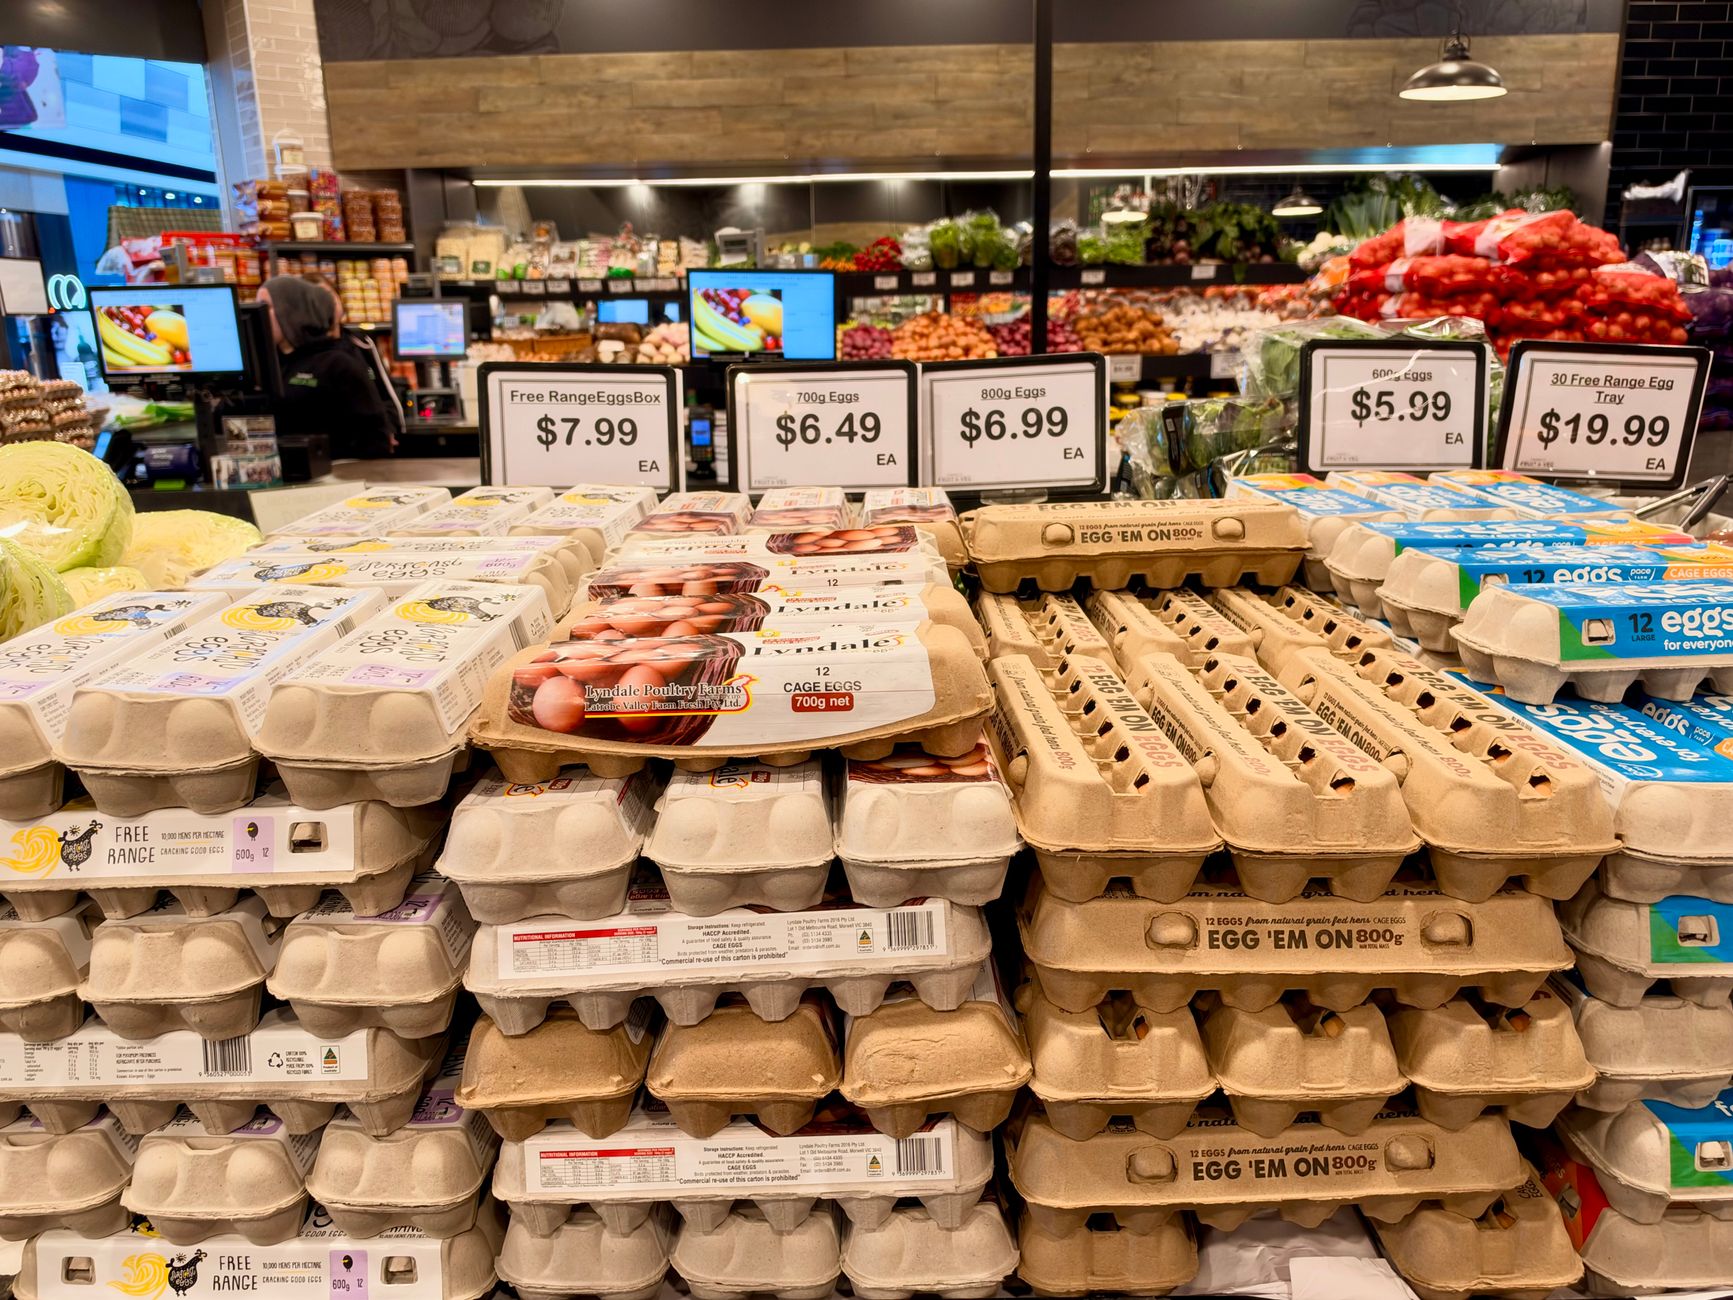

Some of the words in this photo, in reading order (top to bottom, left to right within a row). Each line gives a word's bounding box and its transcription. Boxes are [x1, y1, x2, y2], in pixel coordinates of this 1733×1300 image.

[1404, 369, 1433, 382] Eggs
[1551, 373, 1567, 385] 30
[1571, 374, 1599, 386] Free
[1603, 375, 1646, 389] Range
[1649, 377, 1674, 391] Egg
[510, 390, 545, 403] Free
[549, 391, 660, 406] RangeEggsBox
[797, 392, 826, 404] 700g
[829, 391, 860, 403] Eggs
[981, 388, 1011, 400] 800g
[1015, 387, 1046, 399] Eggs
[1596, 391, 1625, 404] Tray
[1351, 386, 1452, 428] $5.99
[536, 413, 638, 452] $7.99
[775, 411, 881, 452] $6.49
[960, 406, 1068, 449] $6.99
[1537, 408, 1670, 450] $19.99
[1445, 433, 1464, 444] EA
[876, 454, 897, 466] EA
[1063, 447, 1084, 459] EA
[638, 460, 660, 473] EA
[1646, 458, 1665, 470] EA
[1081, 531, 1113, 543] EGG
[1117, 530, 1143, 542] 'EM
[1147, 529, 1171, 541] ON
[1172, 528, 1203, 538] 800g
[827, 579, 839, 587] 12
[1523, 569, 1545, 584] 12
[1553, 566, 1622, 583] eggs
[1630, 568, 1651, 576] pace
[1670, 567, 1700, 578] CAGE
[1703, 567, 1733, 578] EGGS
[779, 600, 897, 613] Lyndale
[1628, 613, 1654, 633] 12
[1661, 606, 1733, 637] eggs
[754, 639, 891, 656] Lyndale
[1664, 639, 1681, 650] for
[1682, 639, 1733, 651] everyon
[816, 666, 830, 676] 12
[1081, 664, 1105, 673] 12
[1233, 663, 1260, 674] 12
[1399, 660, 1421, 670] 12
[783, 681, 821, 693] CAGE
[825, 680, 862, 692] EGGS
[1088, 675, 1124, 694] EGG
[1245, 675, 1287, 697] EGG
[1409, 671, 1457, 692] EGG
[585, 684, 640, 701] Lyndale
[643, 682, 697, 699] Poultry
[698, 682, 742, 696] Farms
[584, 701, 621, 712] Latrobe
[623, 700, 651, 712] Valley
[652, 699, 677, 711] Farm
[678, 699, 704, 710] Fresh
[724, 698, 742, 708] Ltd.
[795, 696, 826, 709] 700g
[829, 695, 850, 706] net
[1106, 695, 1140, 712] 'EM
[1274, 698, 1311, 716] 'EM
[1449, 693, 1490, 711] 'EM
[1119, 715, 1157, 732] ON
[1151, 706, 1166, 730] EGG
[1176, 734, 1187, 755] ON
[1294, 718, 1336, 737] ON
[1476, 714, 1523, 732] ON
[1315, 701, 1336, 726] EGG
[1337, 717, 1351, 738] 'EM
[1351, 731, 1365, 751] ON
[1364, 741, 1383, 763] 800g
[1526, 703, 1658, 761] eggs
[1132, 735, 1183, 768] EGGS
[1316, 738, 1380, 772] EGGS
[1505, 734, 1579, 770] EGGS
[1668, 746, 1709, 762] for
[115, 826, 149, 843] FREE
[107, 846, 155, 865] RANGE
[160, 847, 189, 855] CRACKING
[190, 846, 207, 854] GOOD
[209, 846, 224, 854] EGGS
[236, 849, 254, 862] 600g
[262, 847, 269, 858] 12
[1206, 917, 1215, 925] 12
[1217, 917, 1243, 926] EGGS
[1245, 916, 1270, 927] from
[1270, 916, 1305, 925] natural
[1306, 917, 1331, 927] grain
[1331, 916, 1348, 926] fed
[1349, 916, 1370, 925] hens
[1208, 929, 1260, 950] EGG
[1267, 929, 1308, 949] 'EM
[1315, 929, 1353, 949] ON
[1355, 928, 1404, 946] 800g
[1190, 1150, 1199, 1158] 12
[1201, 1149, 1225, 1158] EGGS
[1227, 1148, 1250, 1158] from
[1251, 1146, 1283, 1155] natural
[1284, 1146, 1307, 1156] grain
[1308, 1144, 1325, 1155] fed
[1325, 1144, 1346, 1153] hens
[1347, 1143, 1363, 1151] CAGE
[1363, 1143, 1379, 1151] EGGS
[1192, 1160, 1242, 1181] EGG
[1248, 1158, 1288, 1179] 'EM
[1293, 1156, 1330, 1178] ON
[1331, 1154, 1377, 1171] 800g
[219, 1255, 251, 1271] FREE
[213, 1274, 258, 1291] RANGE
[262, 1276, 289, 1284] CRACKING
[332, 1279, 351, 1292] 600g
[357, 1278, 363, 1288] 12
